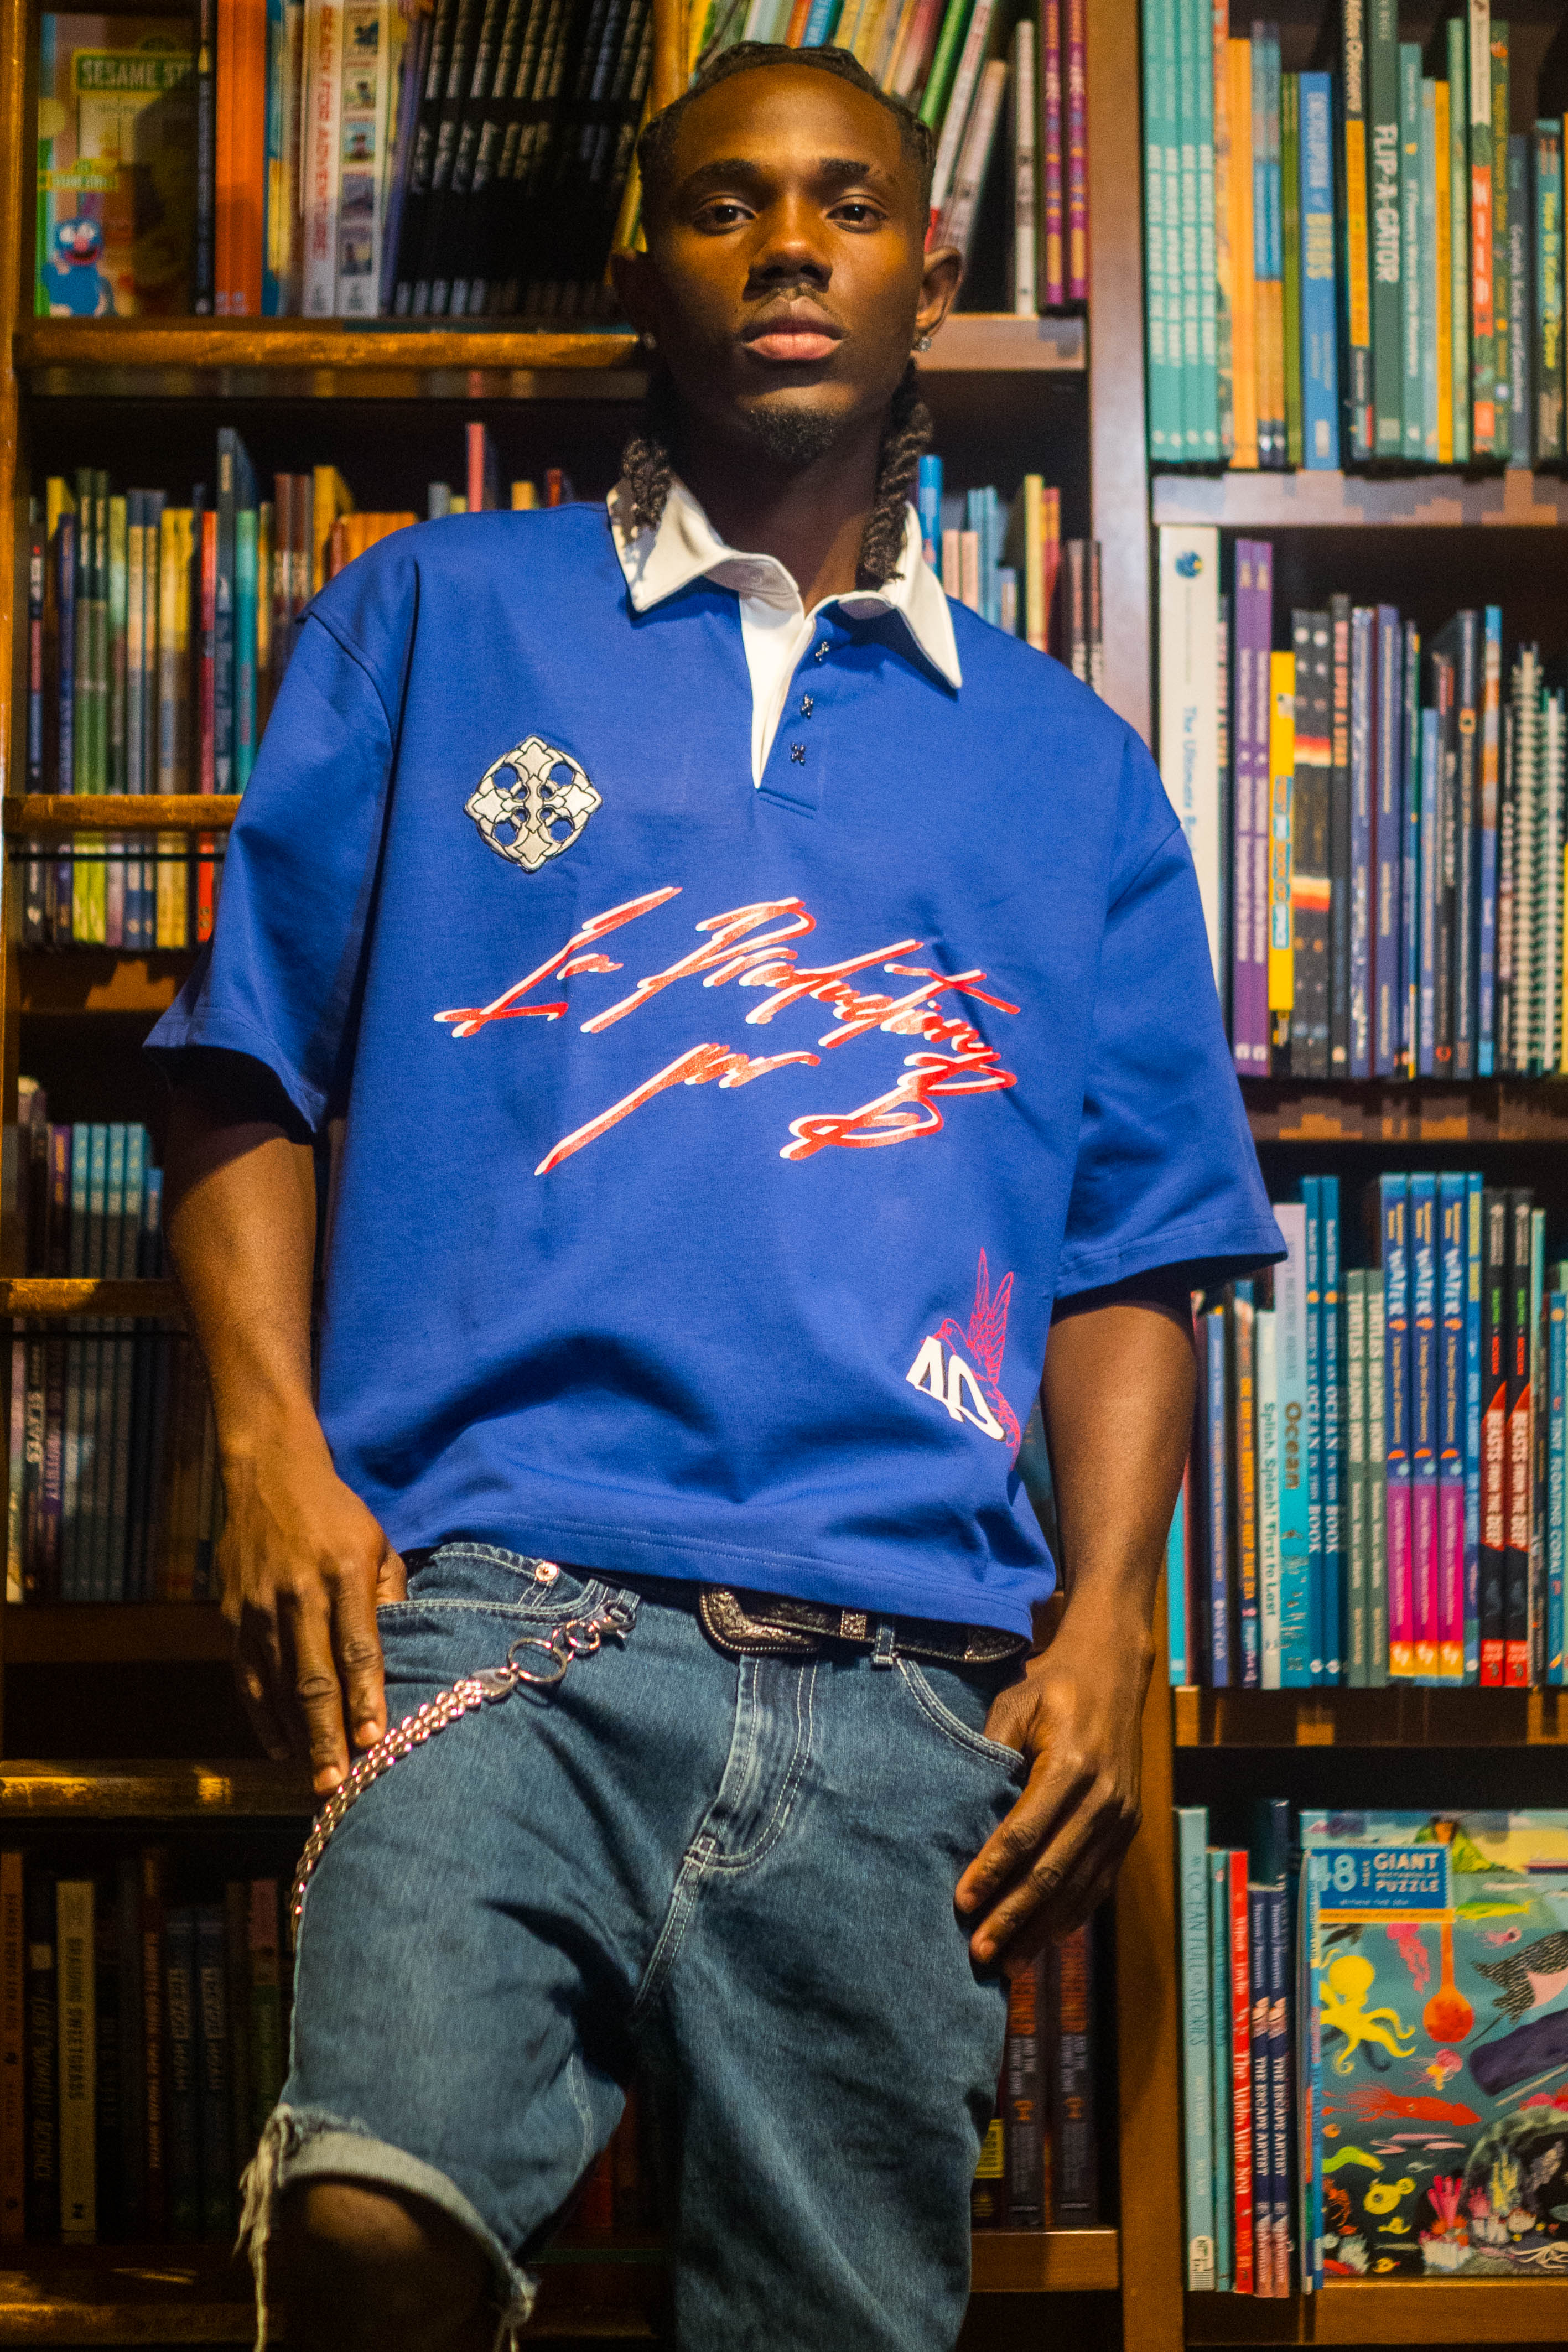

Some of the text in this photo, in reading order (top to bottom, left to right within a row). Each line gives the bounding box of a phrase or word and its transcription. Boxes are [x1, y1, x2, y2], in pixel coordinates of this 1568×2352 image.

[82, 59, 157, 86] SESAME
[1373, 123, 1399, 283] FLIP-A-GATOR
[1182, 705, 1196, 731] The
[1182, 739, 1196, 809] Ultimate
[1388, 1248, 1405, 1316] WATER
[1415, 1248, 1432, 1316] WATER
[1444, 1248, 1461, 1316] WATER
[1349, 1292, 1363, 1359] TURTLES
[1368, 1292, 1383, 1359] TURTLES
[1284, 1401, 1302, 1489] Ocean
[1307, 1384, 1320, 1450] OCEAN
[1325, 1384, 1338, 1450] OCEAN
[1486, 1409, 1504, 1462] BEASTS
[1511, 1410, 1528, 1462] BEASTS
[1261, 1402, 1278, 1616] Splish, Splash! First to Last
[1309, 1505, 1321, 1553] BOOK
[1326, 1505, 1339, 1553] BOOK
[1550, 1529, 1562, 1575] CORAL
[1374, 1853, 1439, 1871] GIANT
[1375, 1879, 1439, 1893] PUZZLE
[1189, 1988, 1206, 2047] STORIES
[1234, 2049, 1250, 2080] The
[1255, 2055, 1269, 2176] THE ESCAPE ARTIST
[1274, 2055, 1287, 2176] THE ESCAPE ARTIST
[1236, 2166, 1251, 2194] Sea
